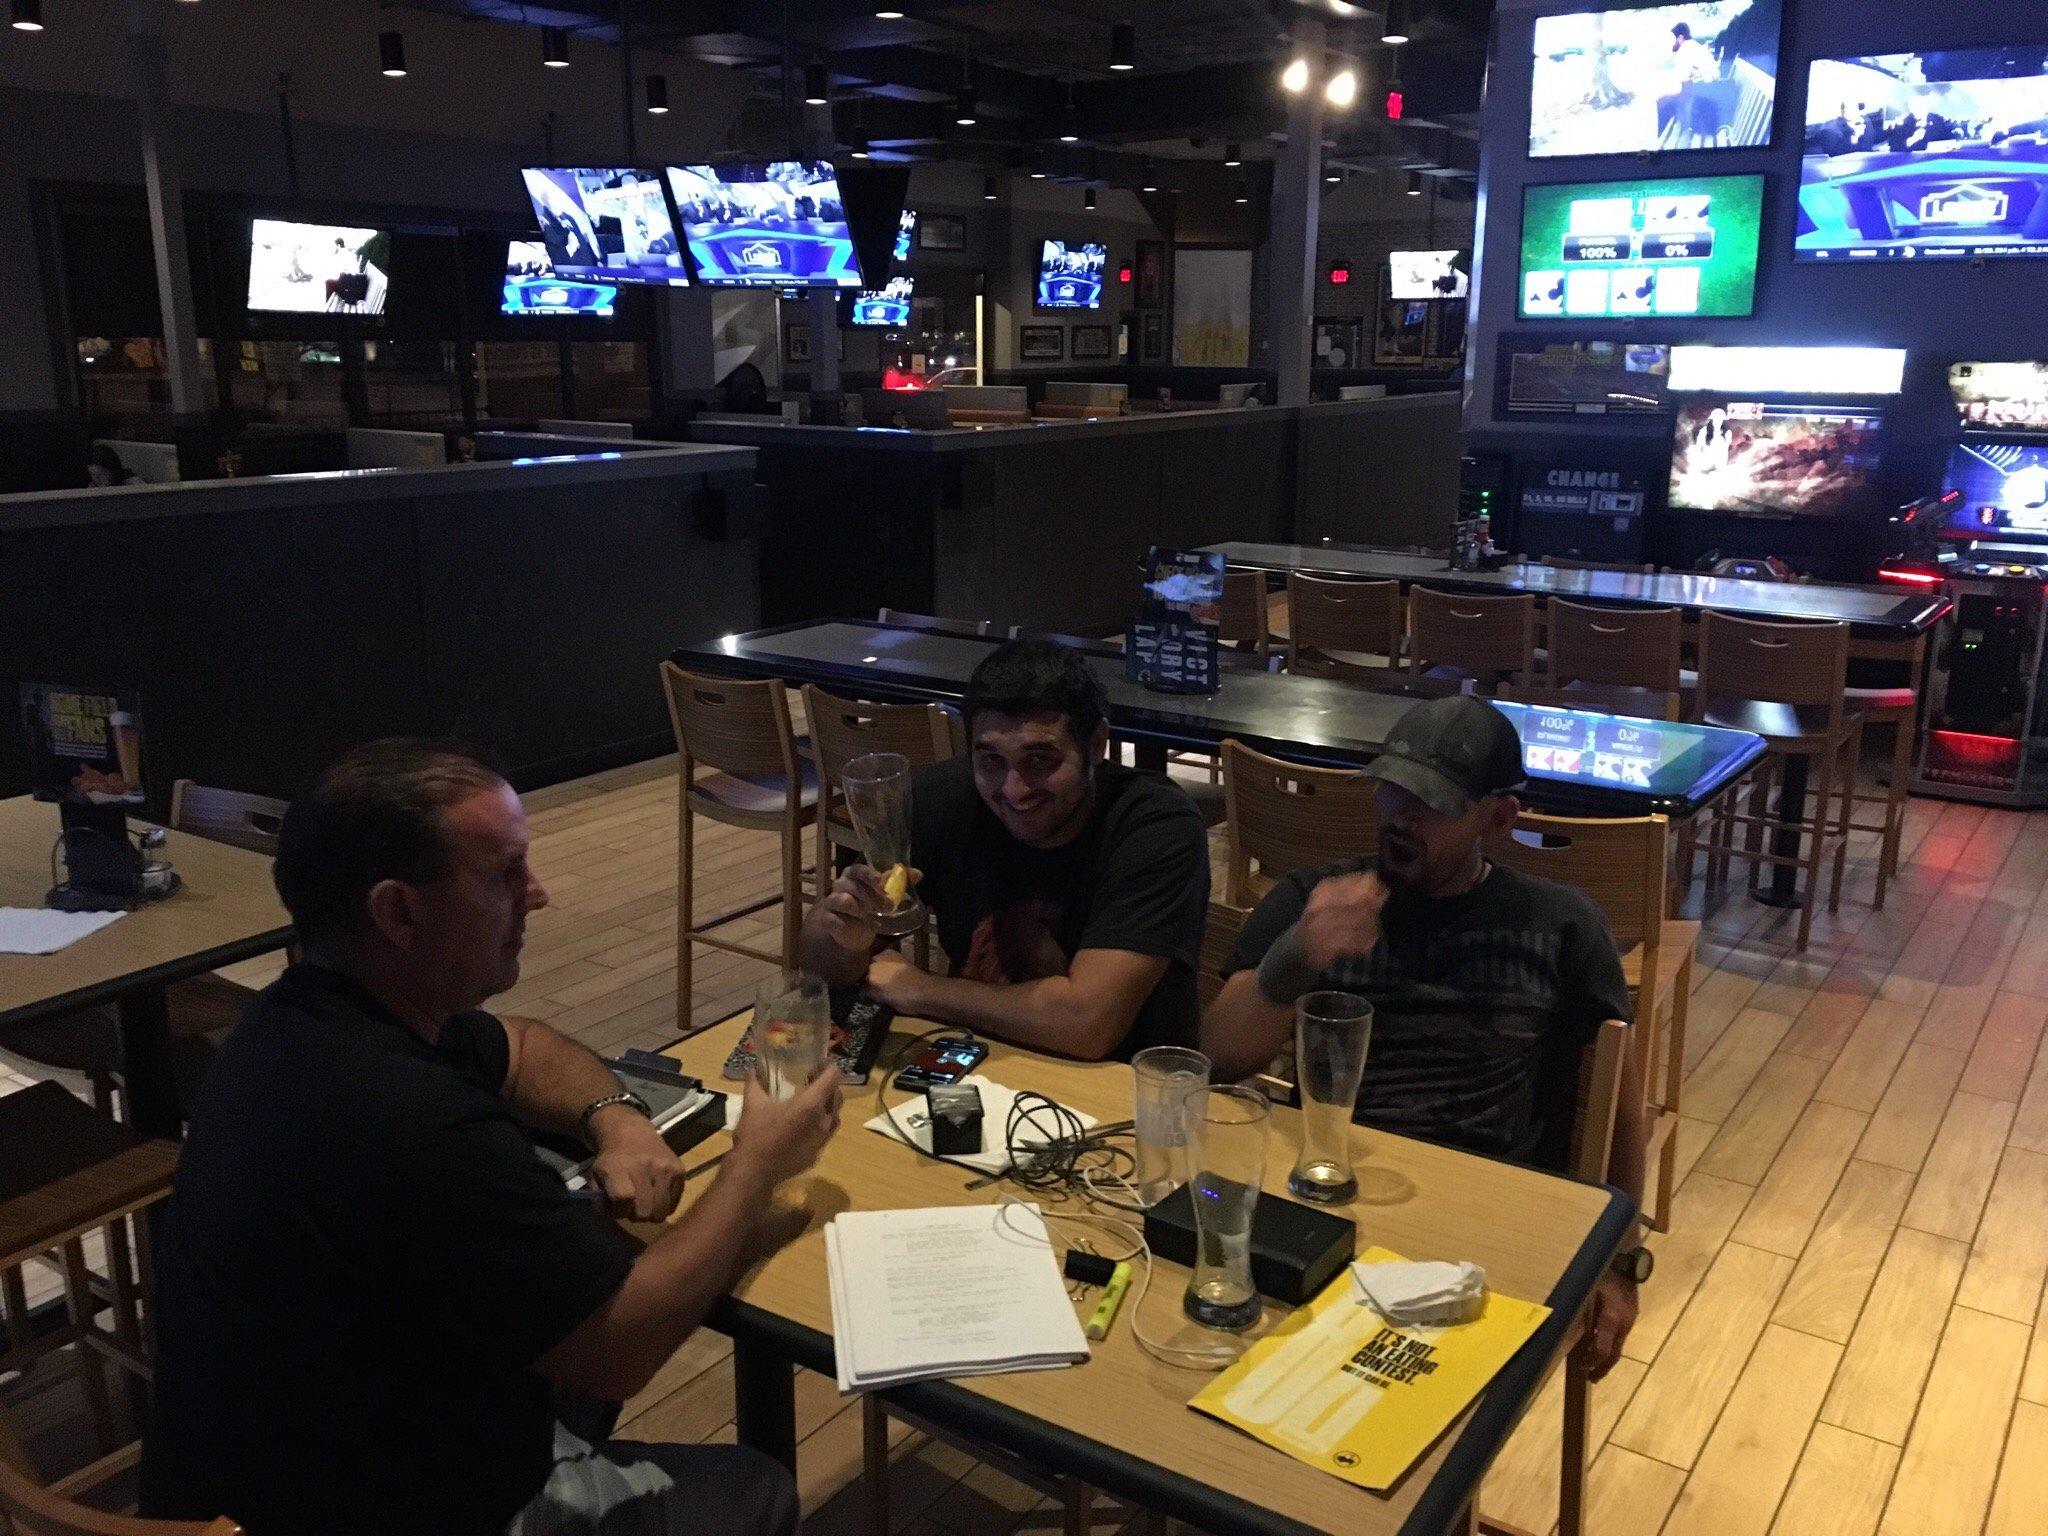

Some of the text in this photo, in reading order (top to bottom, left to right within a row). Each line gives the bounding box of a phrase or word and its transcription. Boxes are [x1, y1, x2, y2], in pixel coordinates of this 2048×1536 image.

[1580, 247, 1617, 259] 100%
[1665, 244, 1689, 257] 0%
[1547, 469, 1620, 488] CHANGE
[1375, 1328, 1437, 1358] IT'S NOT
[1351, 1350, 1420, 1385] CONTEST.
[1362, 1339, 1439, 1375] AN EATING
